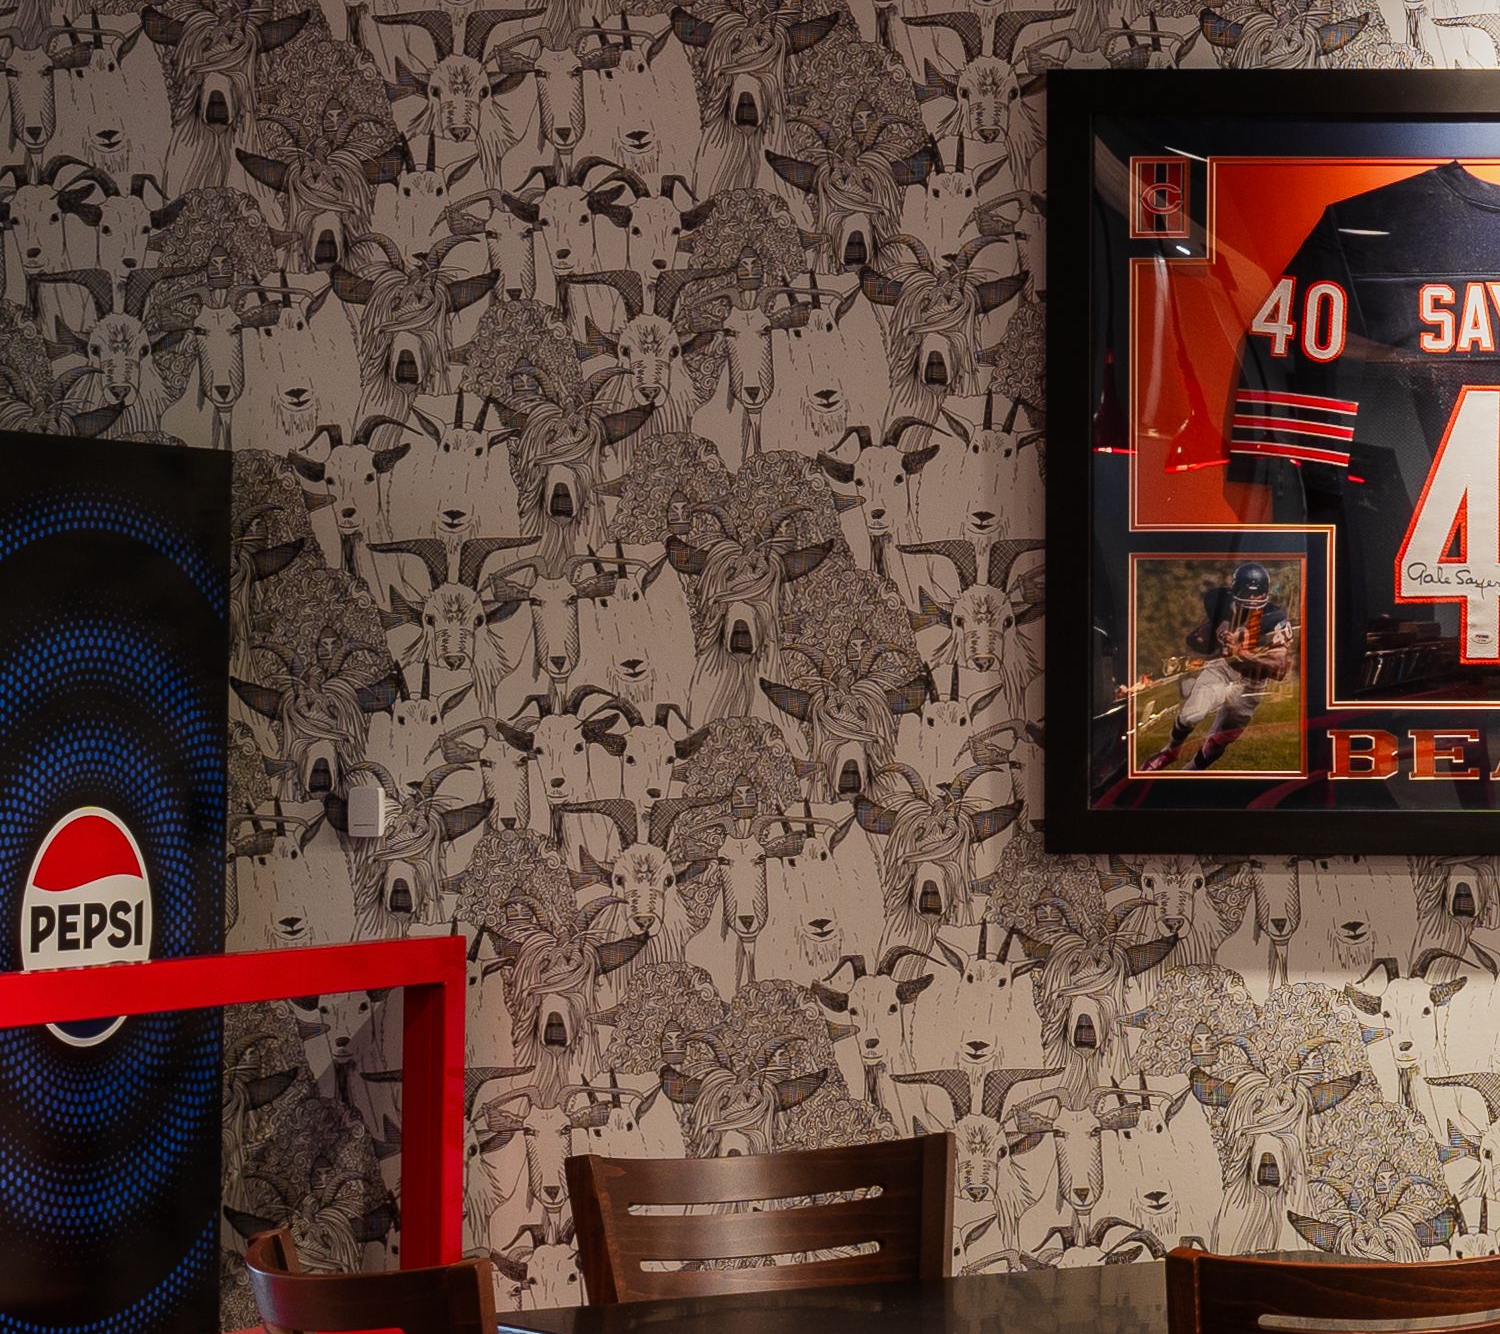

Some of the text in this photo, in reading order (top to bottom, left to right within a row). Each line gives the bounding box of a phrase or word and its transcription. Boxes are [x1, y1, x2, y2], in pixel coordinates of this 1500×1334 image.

[1249, 276, 1347, 363] 40
[1407, 561, 1451, 585] Gale
[30, 900, 144, 954] PEPSI
